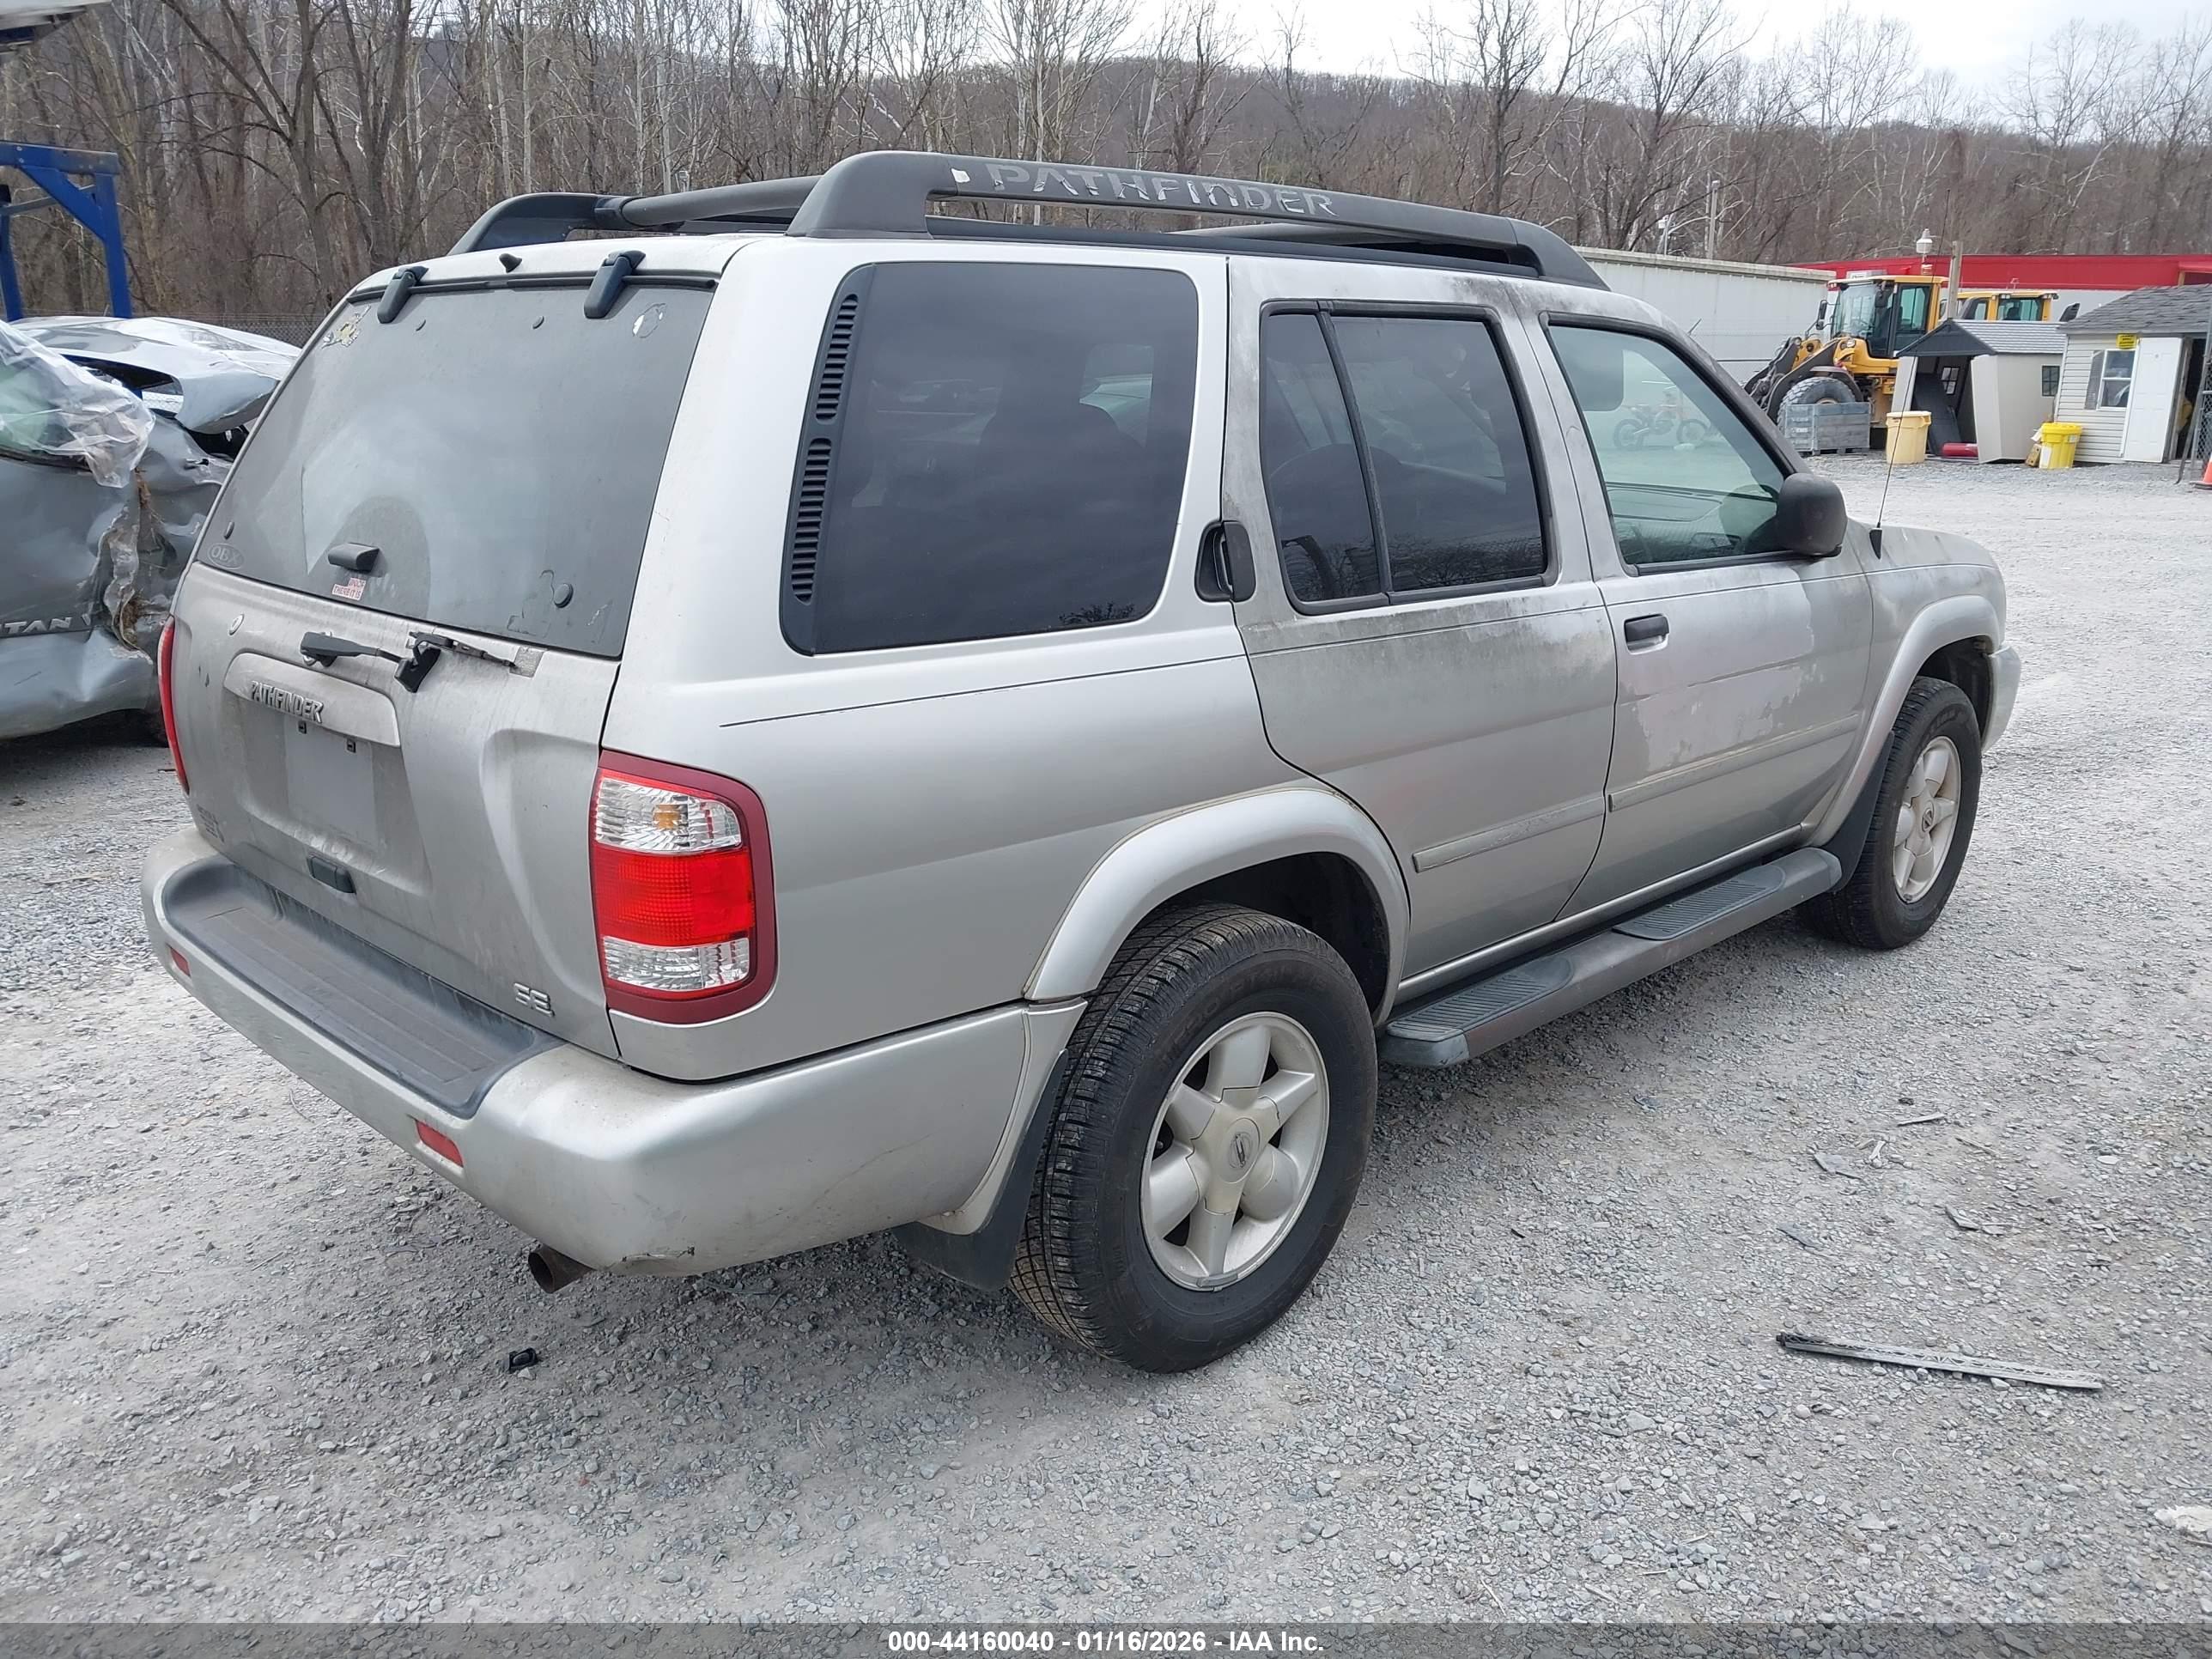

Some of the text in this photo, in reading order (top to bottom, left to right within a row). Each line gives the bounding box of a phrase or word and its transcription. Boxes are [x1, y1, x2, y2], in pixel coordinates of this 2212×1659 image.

[986, 163, 1338, 216] PATHFINDER
[211, 545, 243, 566] OBX
[0, 617, 72, 635] TAN
[251, 680, 323, 723] PATHFINDER
[514, 982, 555, 1017] SE
